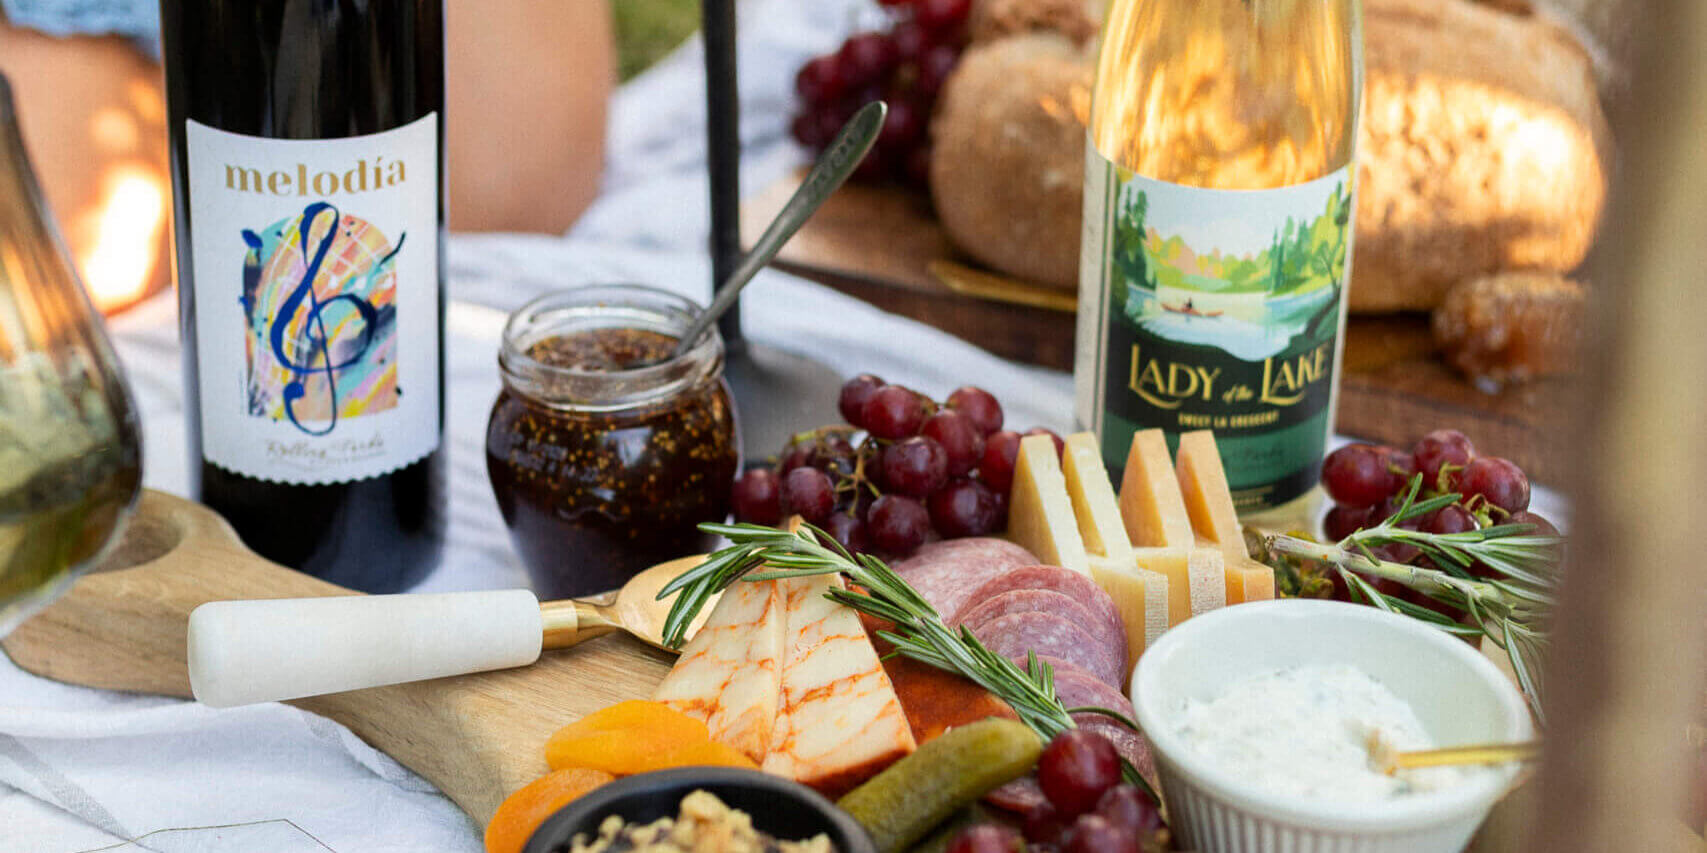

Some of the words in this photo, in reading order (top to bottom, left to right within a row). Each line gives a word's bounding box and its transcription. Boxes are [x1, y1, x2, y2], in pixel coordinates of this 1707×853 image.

[224, 156, 407, 197] melodía
[1128, 343, 1222, 410] LADY
[1259, 340, 1330, 406] LAKE
